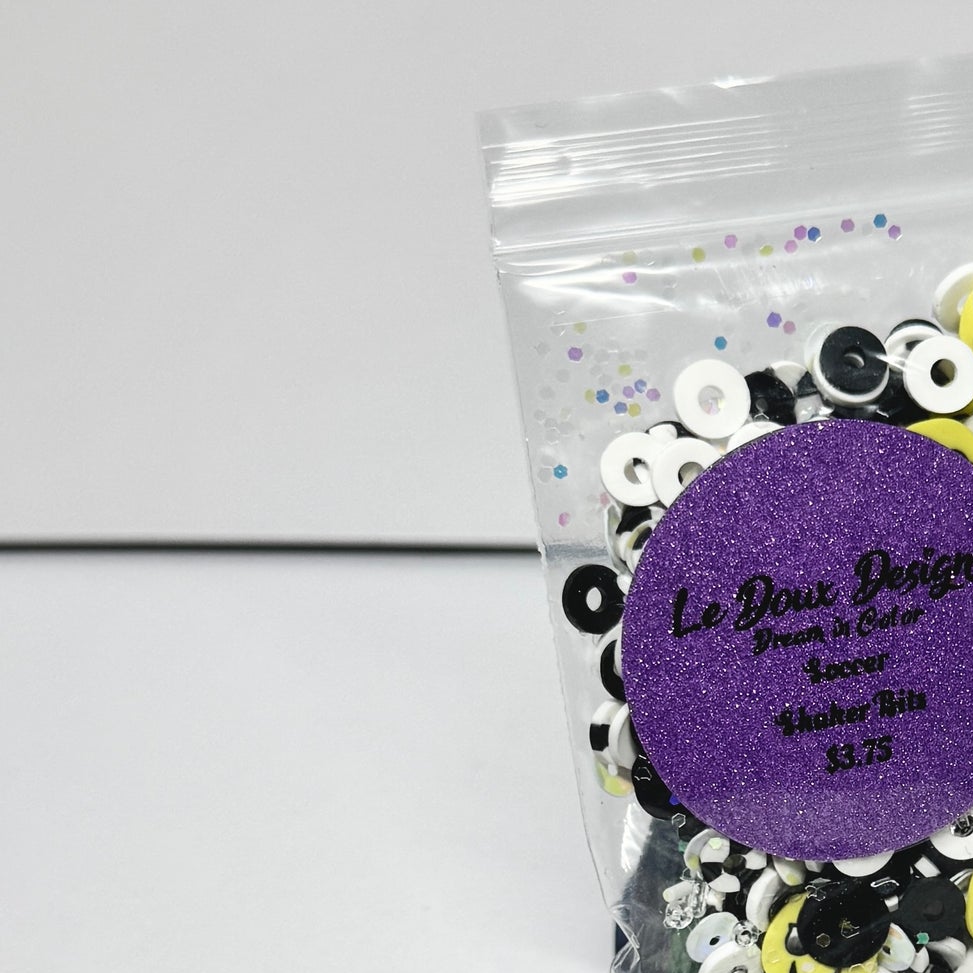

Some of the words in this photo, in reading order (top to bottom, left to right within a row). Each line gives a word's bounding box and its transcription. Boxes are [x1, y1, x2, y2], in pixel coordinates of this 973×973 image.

[669, 588, 727, 638] Le
[733, 575, 838, 631] Doux
[752, 627, 825, 656] Dream
[832, 617, 850, 638] in
[856, 606, 925, 637] Color
[803, 652, 889, 684] Soccer
[774, 700, 870, 737] Shaker
[872, 688, 927, 719] Bits
[825, 735, 893, 775] $3.75
